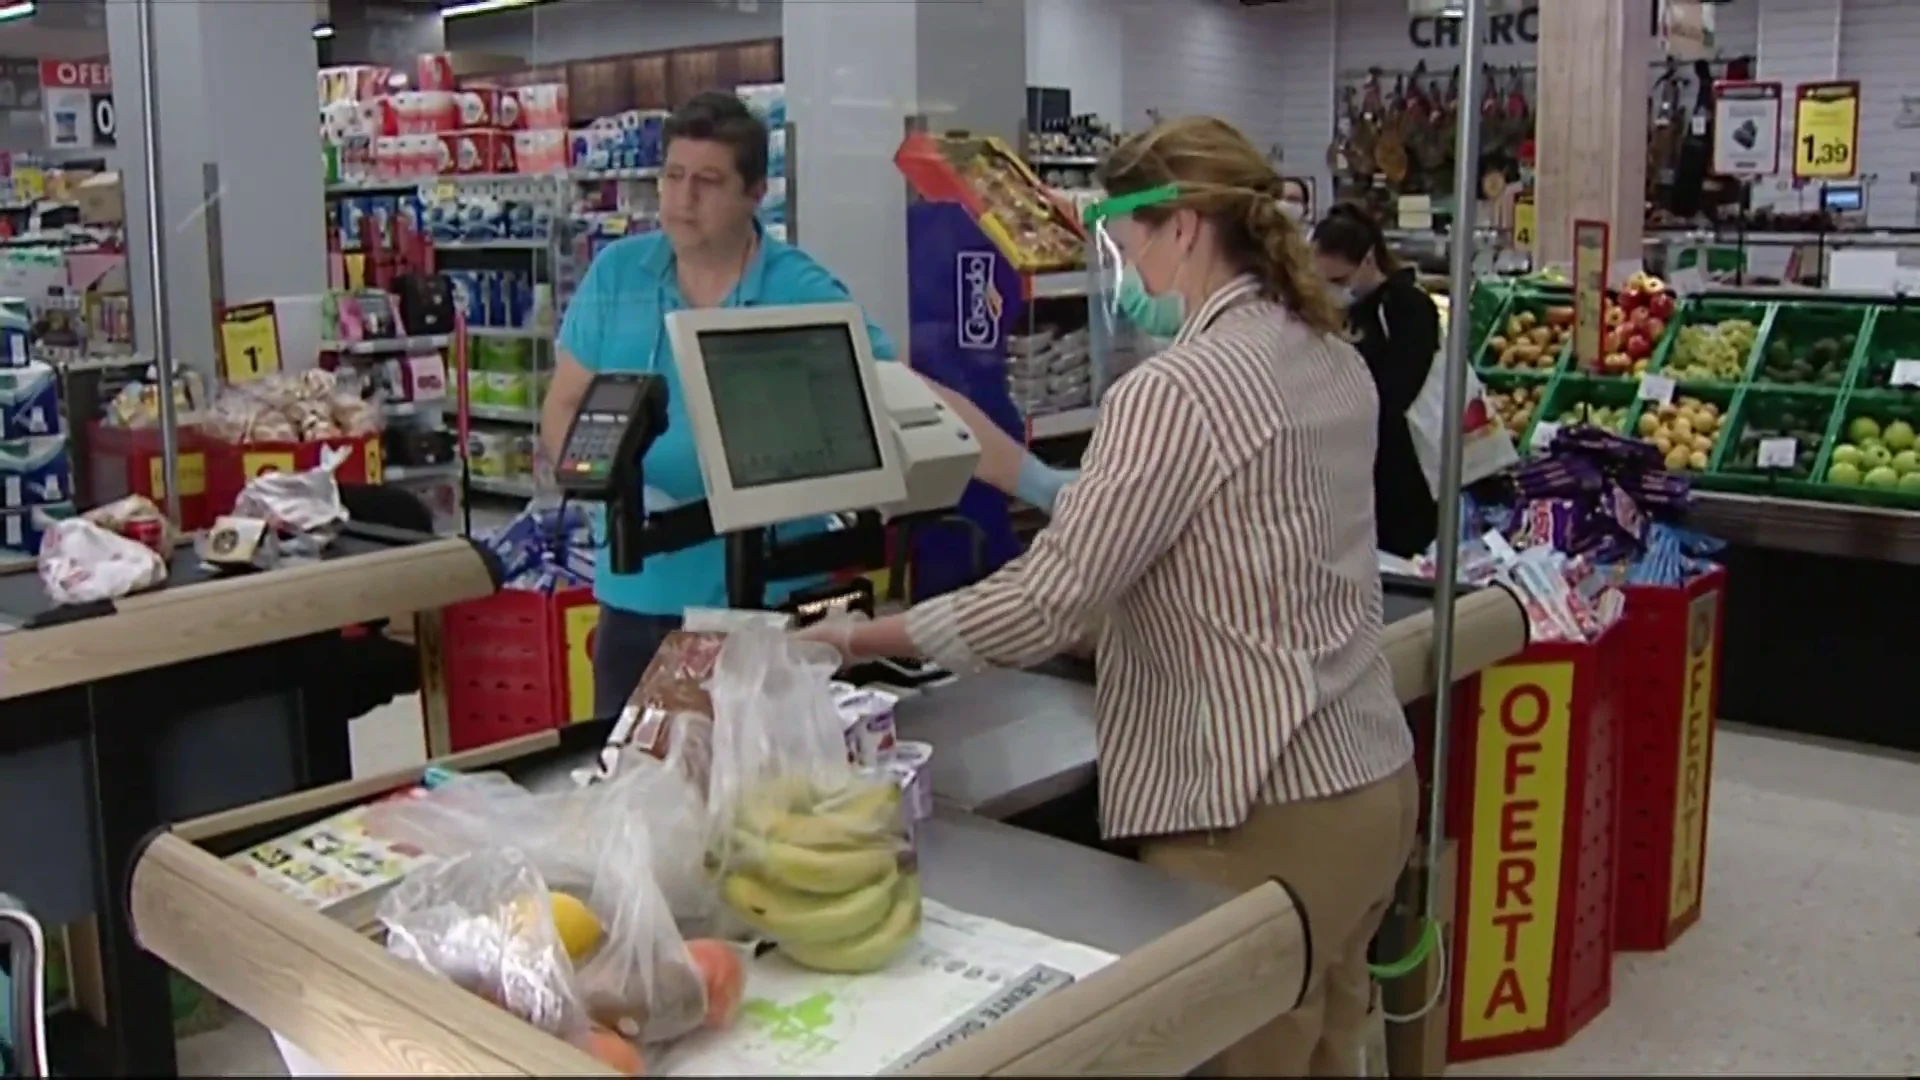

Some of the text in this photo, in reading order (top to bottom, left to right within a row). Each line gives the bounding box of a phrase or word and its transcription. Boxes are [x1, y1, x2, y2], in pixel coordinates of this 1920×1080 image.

[1408, 5, 1539, 48] CHRC
[1483, 683, 1550, 1020] OFERTA
[1676, 611, 1709, 900] OFERTA
